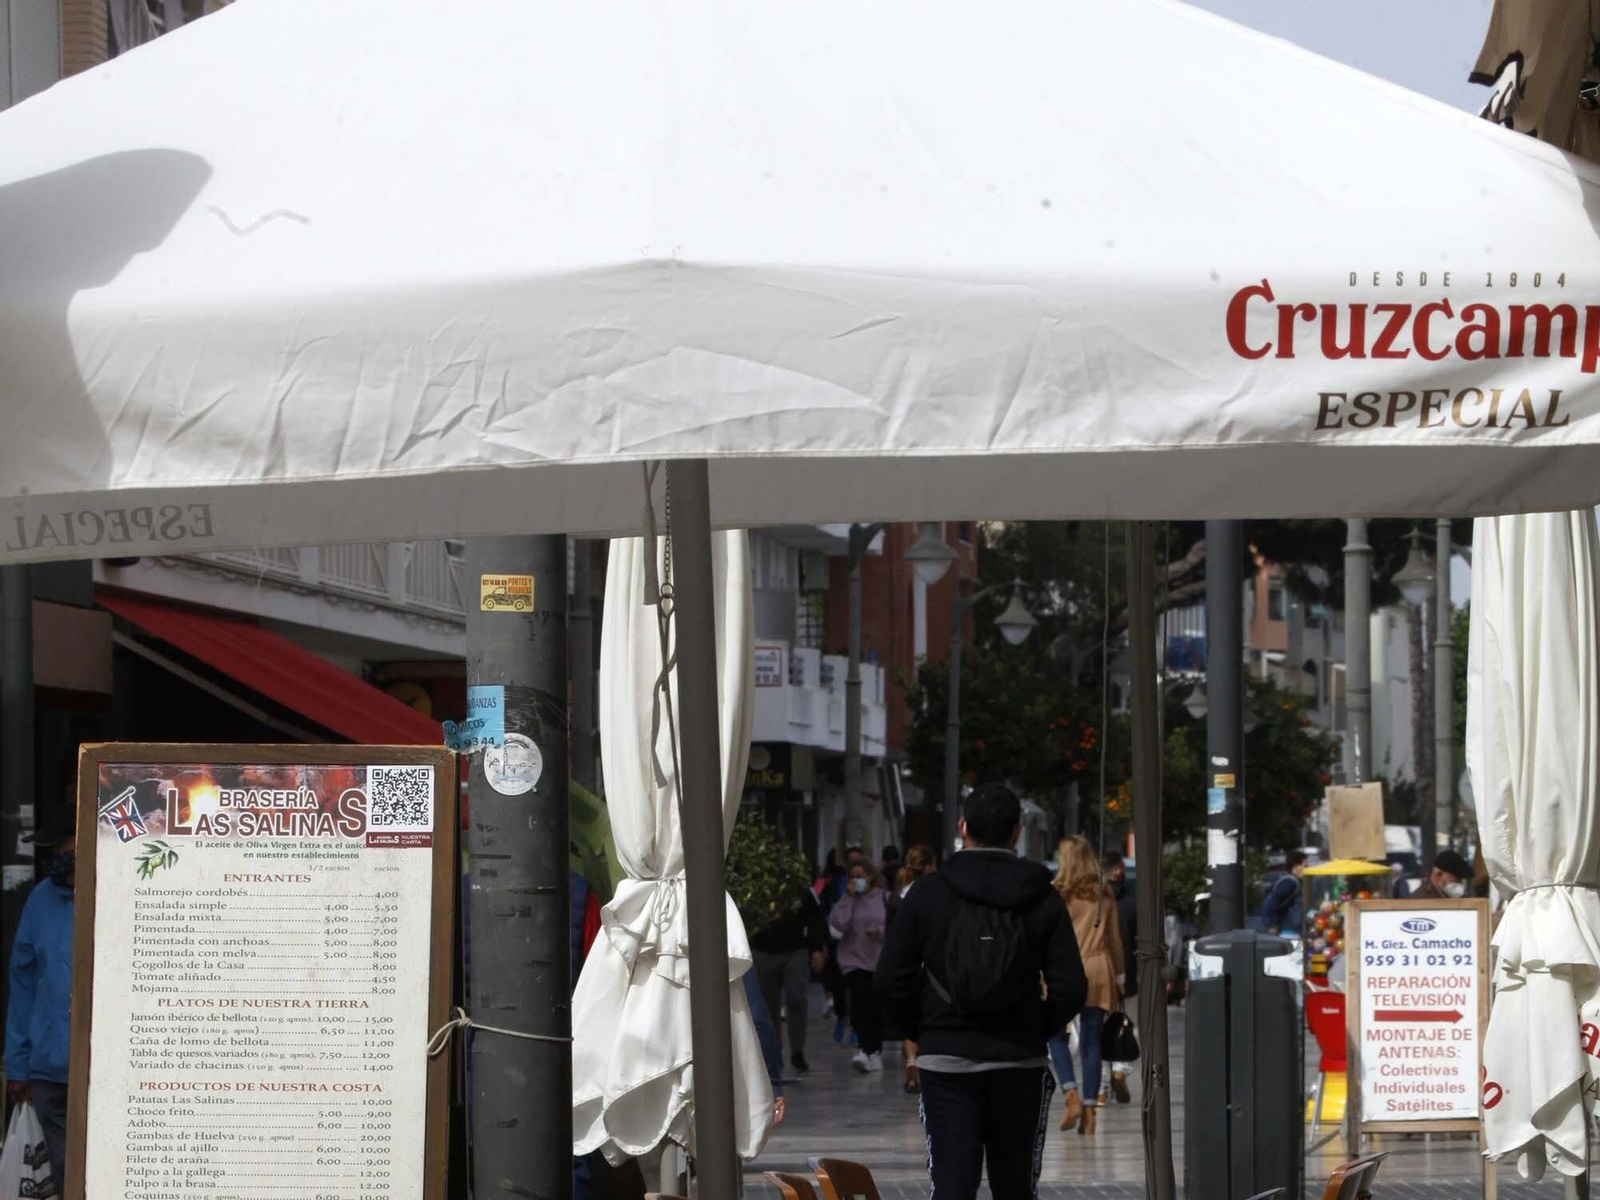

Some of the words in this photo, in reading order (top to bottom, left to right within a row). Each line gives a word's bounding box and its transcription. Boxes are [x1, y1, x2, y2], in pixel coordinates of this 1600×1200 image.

[1350, 272, 1451, 287] DESDE
[1486, 272, 1566, 288] 1904
[1314, 388, 1571, 431] ESPECIAL
[219, 786, 318, 809] BRASERÍA
[167, 789, 231, 837] LAS
[238, 788, 366, 838] SALINAS
[205, 841, 231, 849] aceite
[246, 841, 268, 849] Oliva
[270, 841, 297, 850] Virgen
[256, 851, 289, 859] nuestro
[224, 873, 311, 883] ENTRANTES
[133, 887, 193, 898] Salmorejo
[194, 887, 248, 897] cordobés
[373, 891, 399, 899] 4,00
[134, 900, 185, 909] Ensalada
[188, 900, 227, 911] simple
[373, 904, 398, 912] 5,50
[133, 912, 185, 921] Ensalada
[188, 912, 222, 921] mixta
[373, 916, 398, 925] 7,00
[133, 924, 195, 933] Pimentada
[372, 928, 398, 936] 7,00
[133, 936, 195, 945] Pimentada
[222, 937, 270, 945] anchoas
[372, 939, 398, 947] 8,00
[1364, 940, 1378, 950] M.
[1411, 937, 1472, 950] Camacho
[132, 948, 194, 956] Pimentada
[222, 949, 256, 957] melva
[371, 951, 397, 959] 8,00
[1364, 955, 1396, 967] 959
[1401, 955, 1419, 966] 31
[1426, 955, 1447, 966] 02
[1452, 954, 1473, 966] 92
[130, 972, 175, 980] Tomate
[177, 972, 221, 981] aliñado
[370, 976, 396, 984] 4,50
[1367, 974, 1472, 989] REPARACIÓN
[131, 984, 179, 994] Mojama
[370, 987, 396, 995] 8,00
[157, 998, 214, 1008] PLATOS
[218, 998, 239, 1008] DE
[242, 998, 312, 1008] NUESTRA
[315, 999, 370, 1009] TIERRA
[1372, 991, 1467, 1007] TELEVISIÓN
[130, 1012, 165, 1021] Jamón
[167, 1012, 205, 1021] ibérico
[205, 1013, 220, 1021] de
[221, 1013, 257, 1022] bellota
[315, 1016, 346, 1024] 10,00
[365, 1016, 394, 1024] 15,00
[129, 1025, 168, 1034] Queso
[169, 1025, 199, 1035] viejo
[319, 1026, 345, 1035] 6,50
[1366, 1029, 1447, 1041] MONTAJE
[1451, 1029, 1473, 1041] DE
[128, 1035, 159, 1045] Caña
[162, 1036, 177, 1045] de
[179, 1036, 210, 1045] lomo
[212, 1037, 228, 1045] de
[229, 1036, 269, 1046] bellota
[1378, 1046, 1461, 1059] ANTENAS:
[1380, 1063, 1460, 1077] Colectivas
[139, 1081, 232, 1091] PRODUCTOS
[235, 1082, 258, 1091] DE
[259, 1082, 329, 1092] NUESTRA
[332, 1083, 383, 1092] COSTA
[1373, 1081, 1466, 1094] Individuales
[127, 1095, 168, 1103] Patatas
[171, 1095, 193, 1104] Las
[193, 1095, 235, 1104] Salinas
[1386, 1099, 1454, 1112] Satélites
[126, 1106, 166, 1115] Choco
[168, 1107, 195, 1115] frito
[317, 1110, 342, 1118] 5,00
[127, 1118, 167, 1127] Adobo
[316, 1121, 342, 1129] 6,00
[125, 1143, 173, 1151] Gambas
[175, 1143, 187, 1152] al
[189, 1143, 219, 1154] ajillo
[315, 1145, 342, 1153] 6,00
[125, 1154, 157, 1163] Filete
[159, 1155, 175, 1163] de
[177, 1155, 209, 1164] araña
[315, 1157, 341, 1165] 6,00
